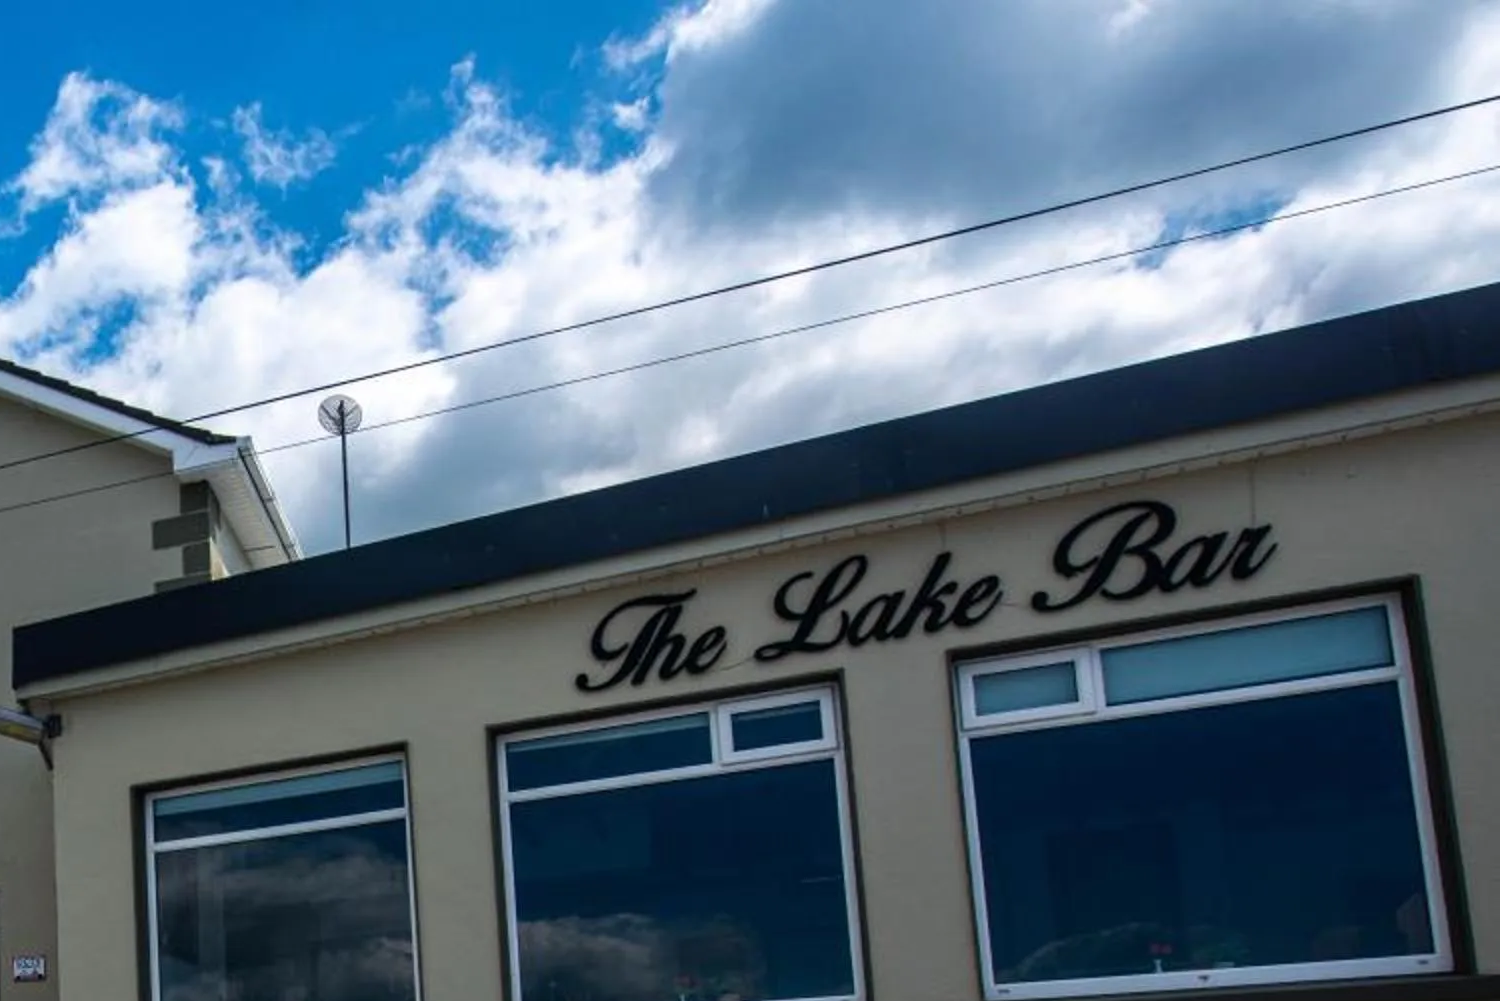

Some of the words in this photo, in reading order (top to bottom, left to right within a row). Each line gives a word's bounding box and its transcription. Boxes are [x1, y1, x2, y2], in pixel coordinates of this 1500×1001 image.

[575, 588, 727, 692] The
[755, 553, 1002, 662] Lake
[1032, 500, 1278, 614] Bar
